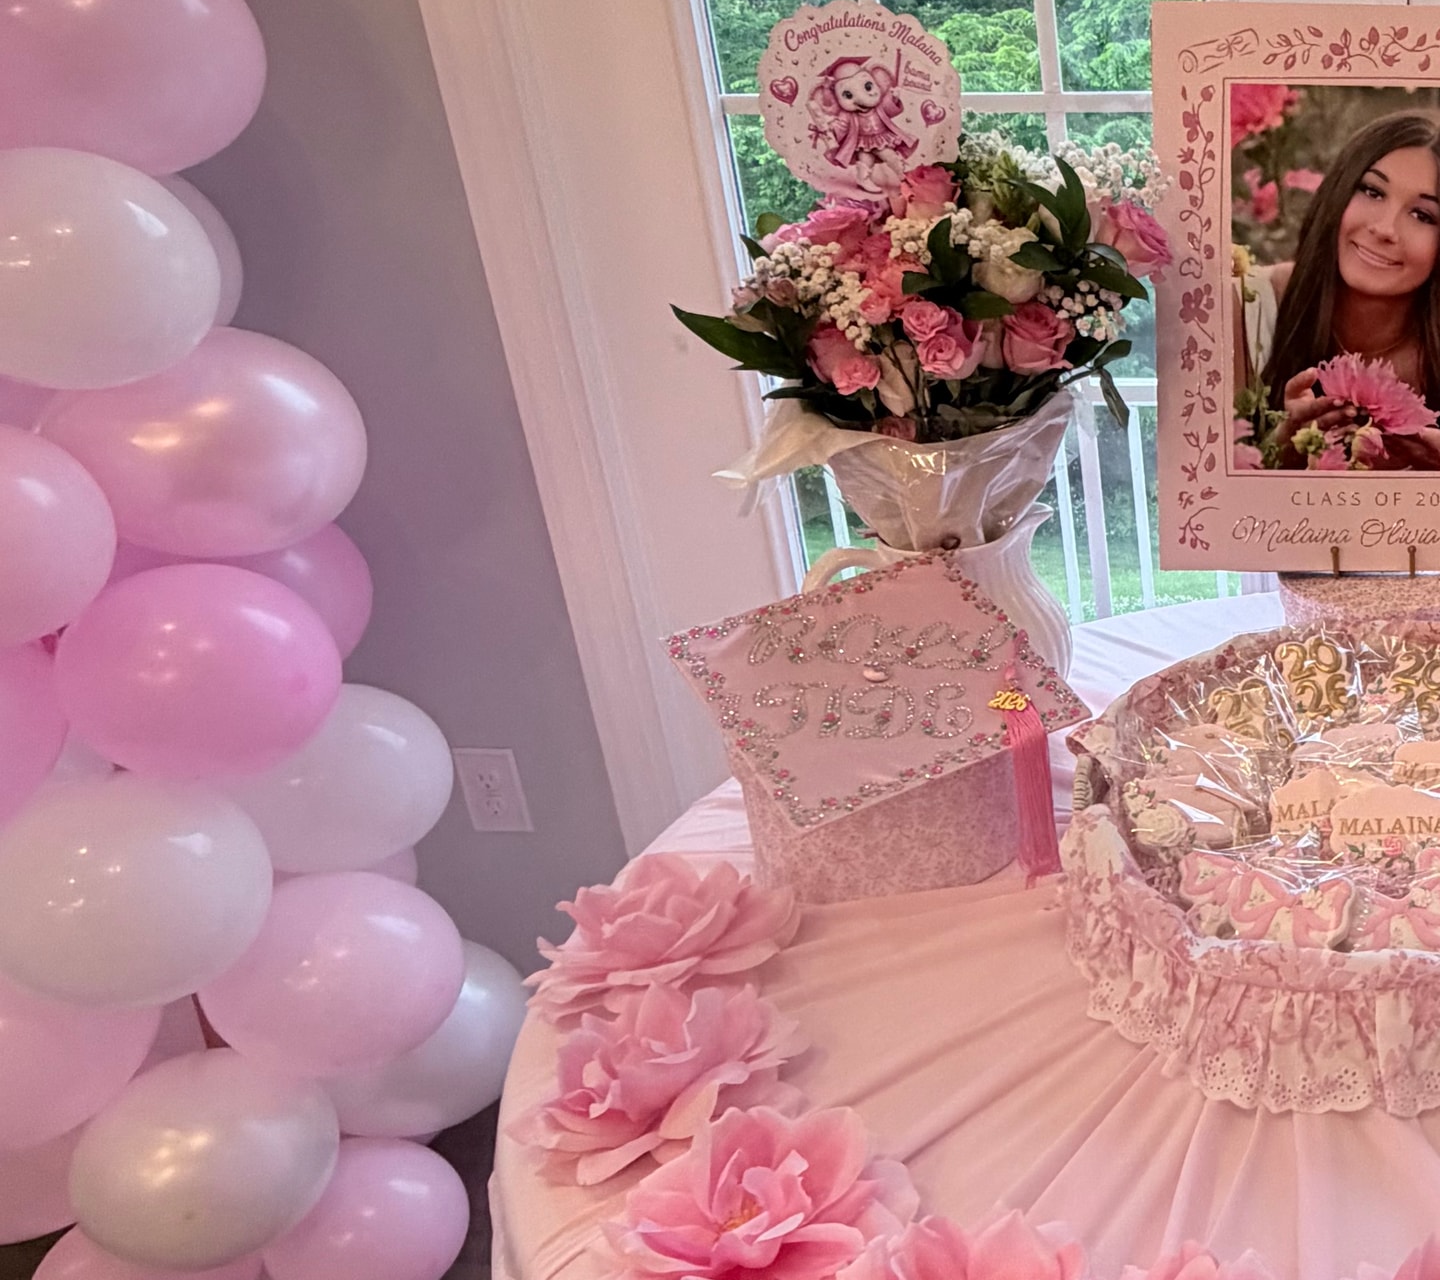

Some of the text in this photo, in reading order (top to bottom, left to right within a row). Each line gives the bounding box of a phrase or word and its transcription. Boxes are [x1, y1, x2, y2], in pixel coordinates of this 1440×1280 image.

[784, 11, 942, 66] Congratulations Malaina
[1291, 491, 1361, 507] CLASS
[1375, 491, 1401, 507] OF
[1232, 515, 1351, 552] Malaina
[1360, 518, 1440, 548] Olivia
[987, 690, 1028, 712] 2026
